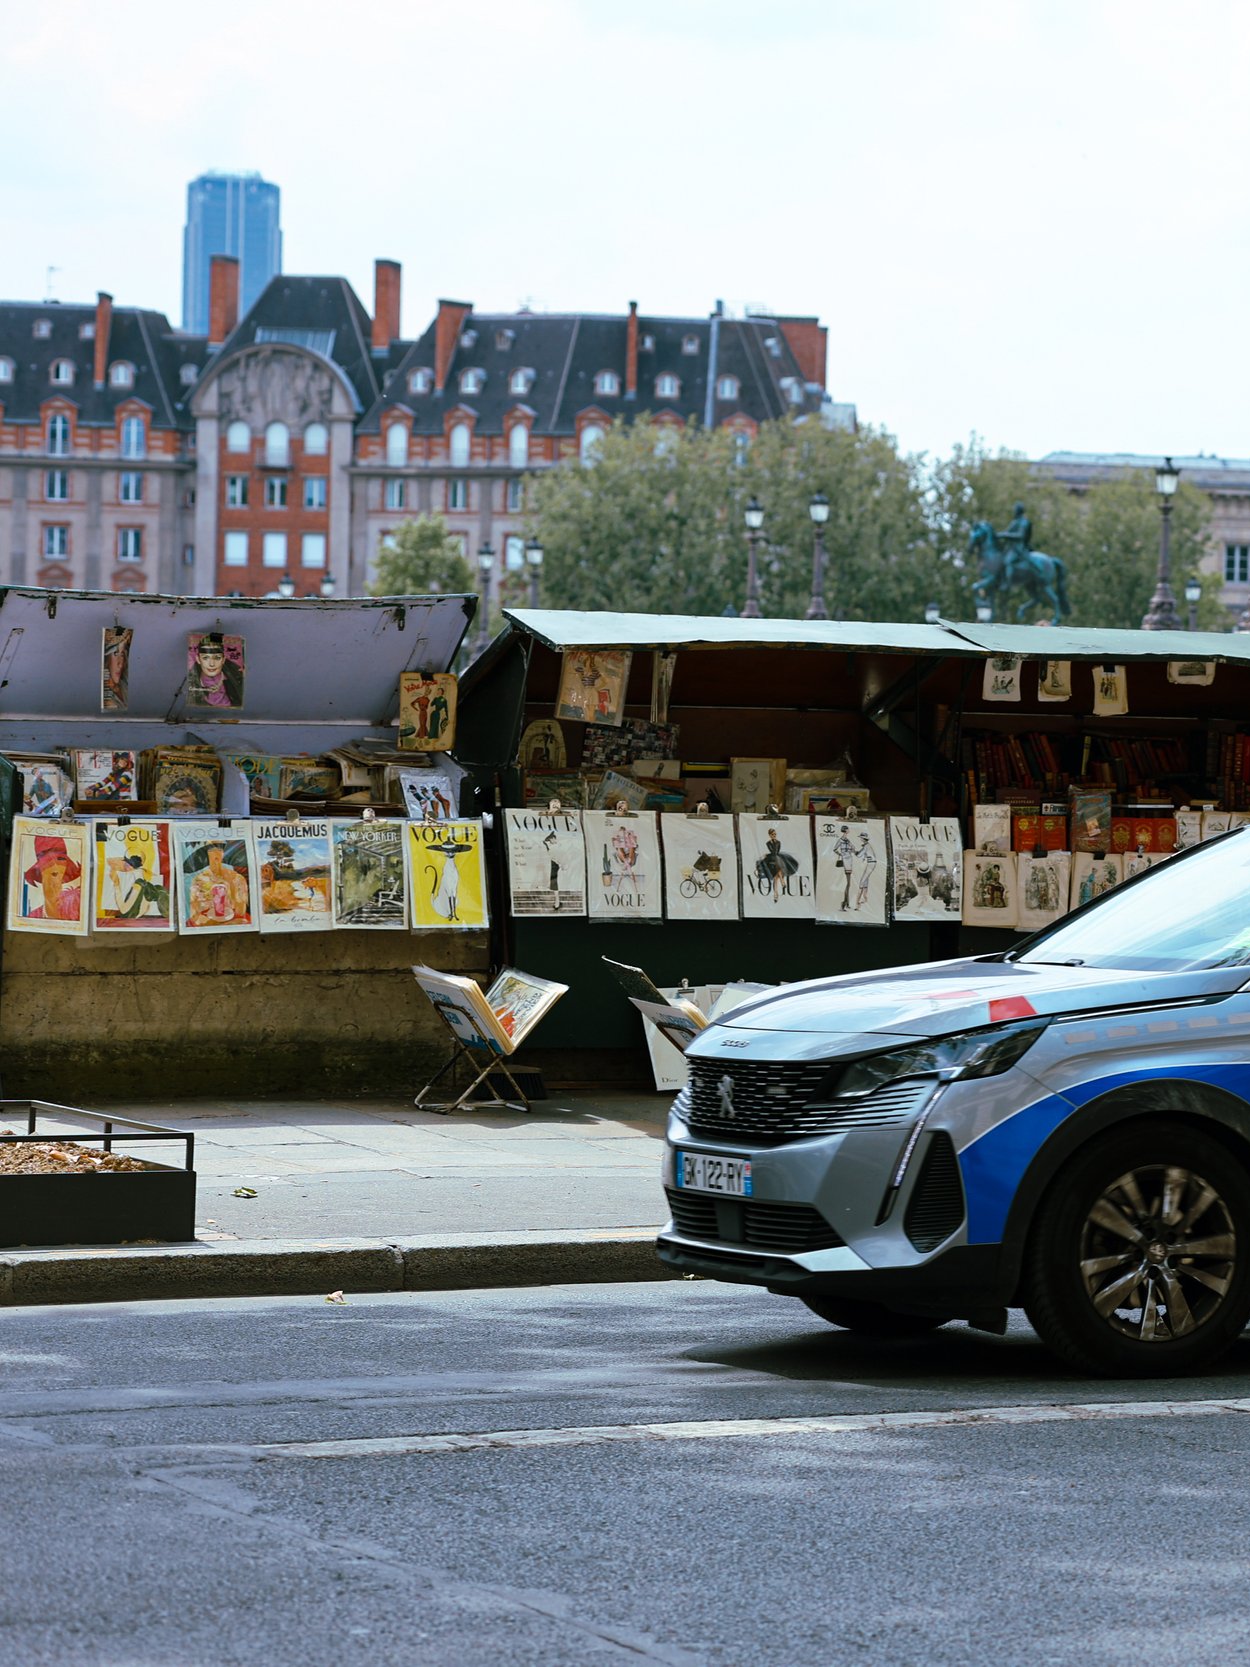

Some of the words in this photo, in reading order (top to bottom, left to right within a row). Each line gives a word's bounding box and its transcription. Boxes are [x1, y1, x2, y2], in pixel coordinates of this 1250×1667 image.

[24, 825, 78, 837] VOGUE
[512, 814, 578, 833] VOGUE
[103, 828, 162, 843] VOGUE
[178, 826, 245, 839] VOGUE
[257, 825, 328, 840] JACQUEMUS
[337, 831, 360, 841] NEW
[360, 831, 397, 842] YORKER
[410, 825, 478, 843] VOGUE
[895, 824, 956, 842] VOGUE
[604, 893, 645, 908] VOGUE
